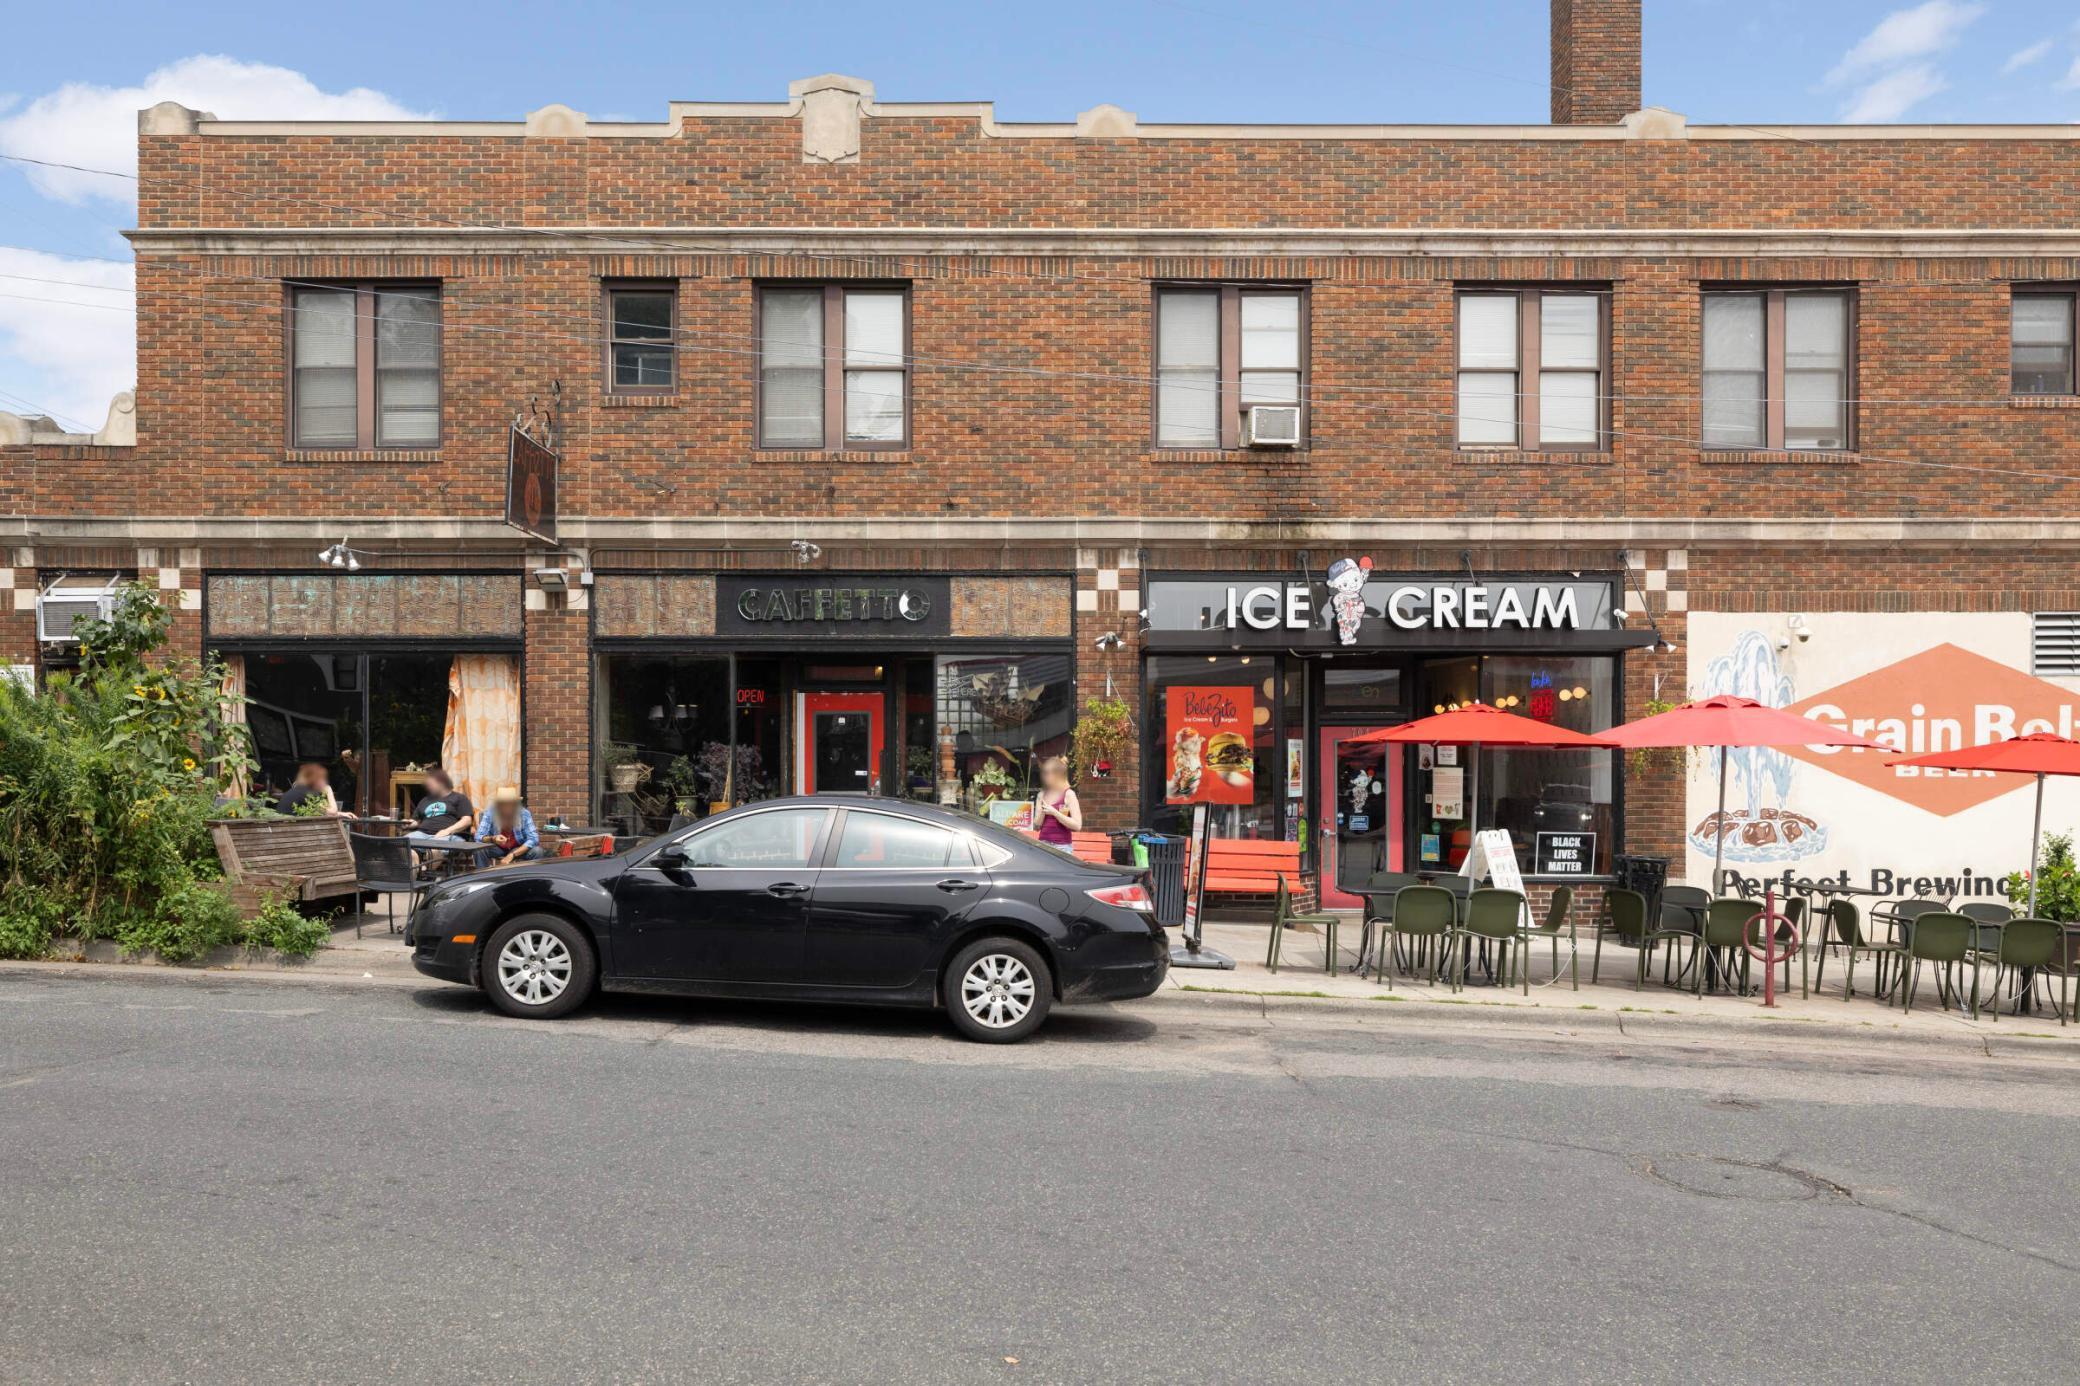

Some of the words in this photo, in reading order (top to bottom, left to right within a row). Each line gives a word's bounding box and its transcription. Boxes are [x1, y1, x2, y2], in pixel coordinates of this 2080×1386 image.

[737, 588, 931, 621] CAFFETTO
[1227, 586, 1310, 629] ICE
[1388, 586, 1580, 629] CREAM
[737, 689, 765, 703] OPEN
[1800, 703, 1962, 754] Grain
[1552, 836, 1581, 847] BLACK
[1553, 849, 1577, 859] LIVES
[1548, 861, 1582, 872] MATTER
